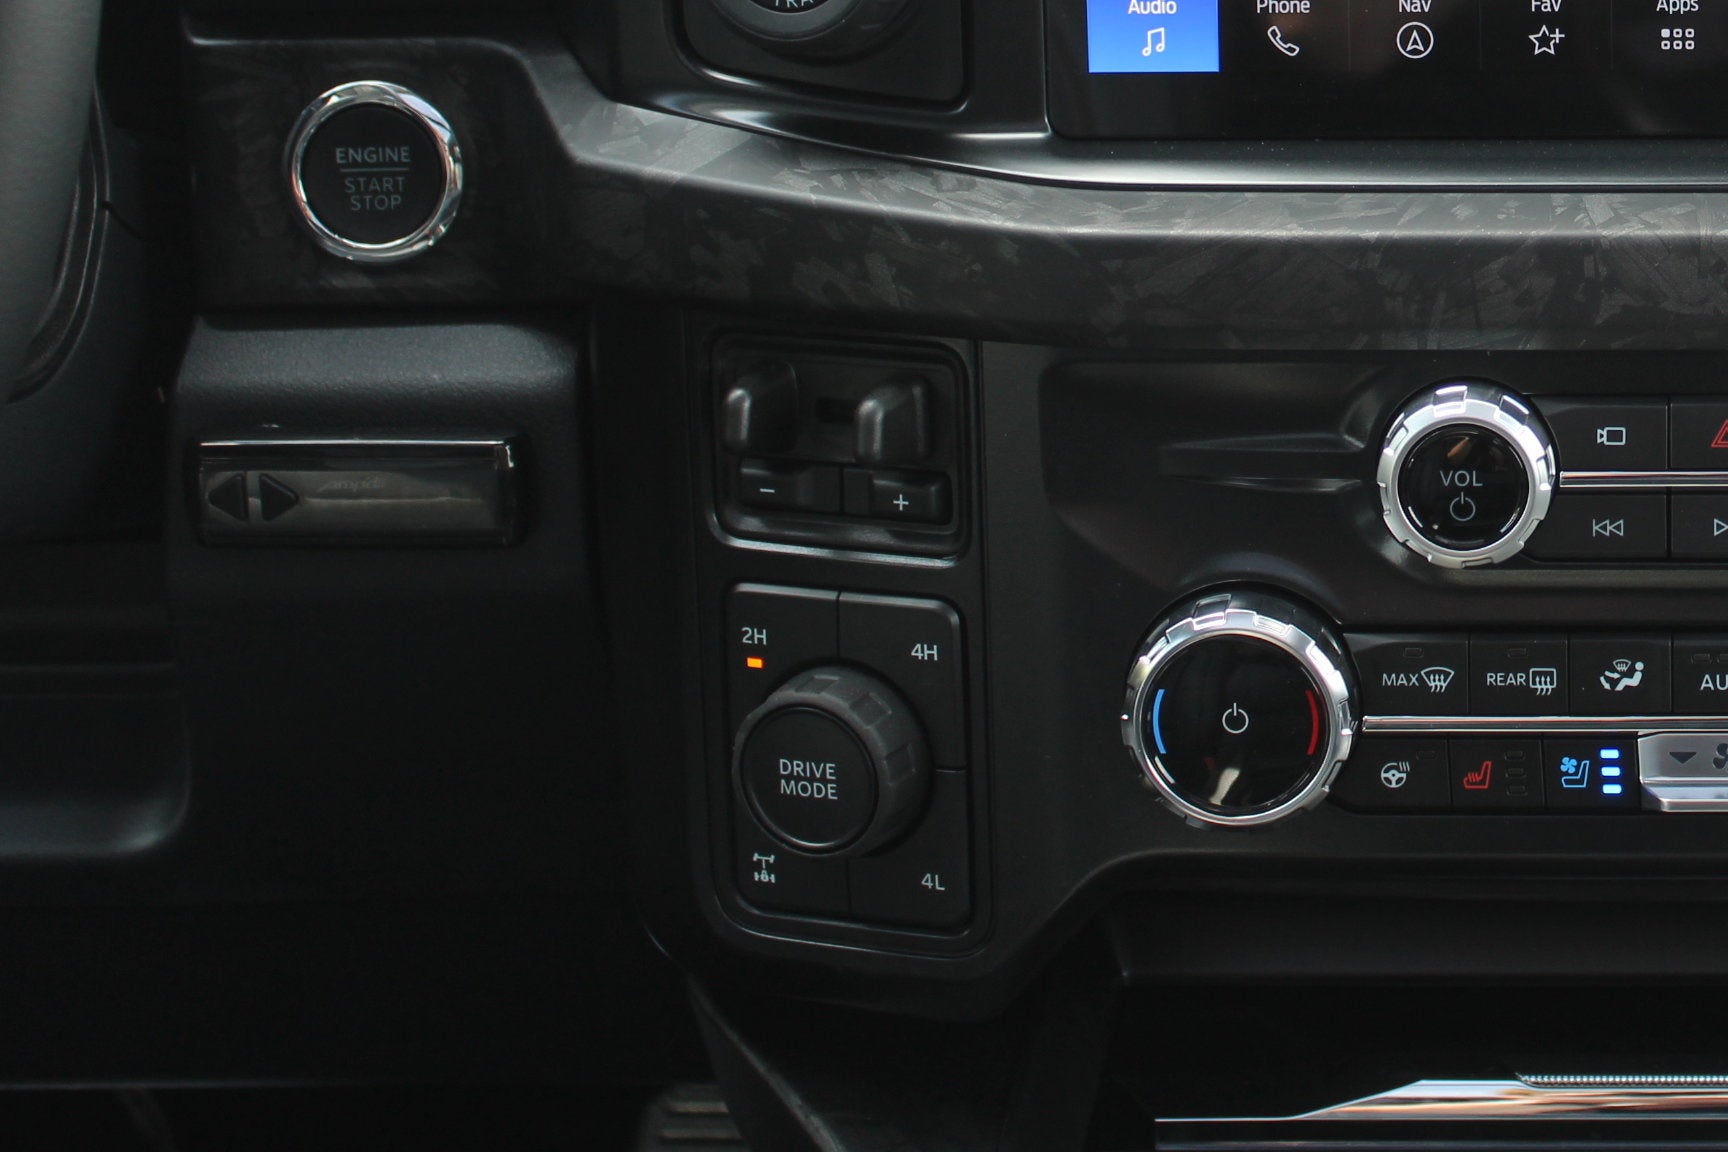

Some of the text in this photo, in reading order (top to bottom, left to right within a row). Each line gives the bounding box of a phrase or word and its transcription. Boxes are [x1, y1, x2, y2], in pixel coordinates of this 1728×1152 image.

[335, 146, 411, 164] ENGINE
[344, 176, 405, 194] START
[350, 194, 402, 212] STOP
[1439, 470, 1483, 487] VOL
[741, 626, 767, 646] 2H
[910, 643, 938, 661] 4H
[1382, 673, 1419, 687] MAX
[1486, 672, 1527, 686] REAR
[779, 759, 837, 781] DRIVE
[779, 778, 838, 800] MODE
[920, 873, 946, 891] 4L
